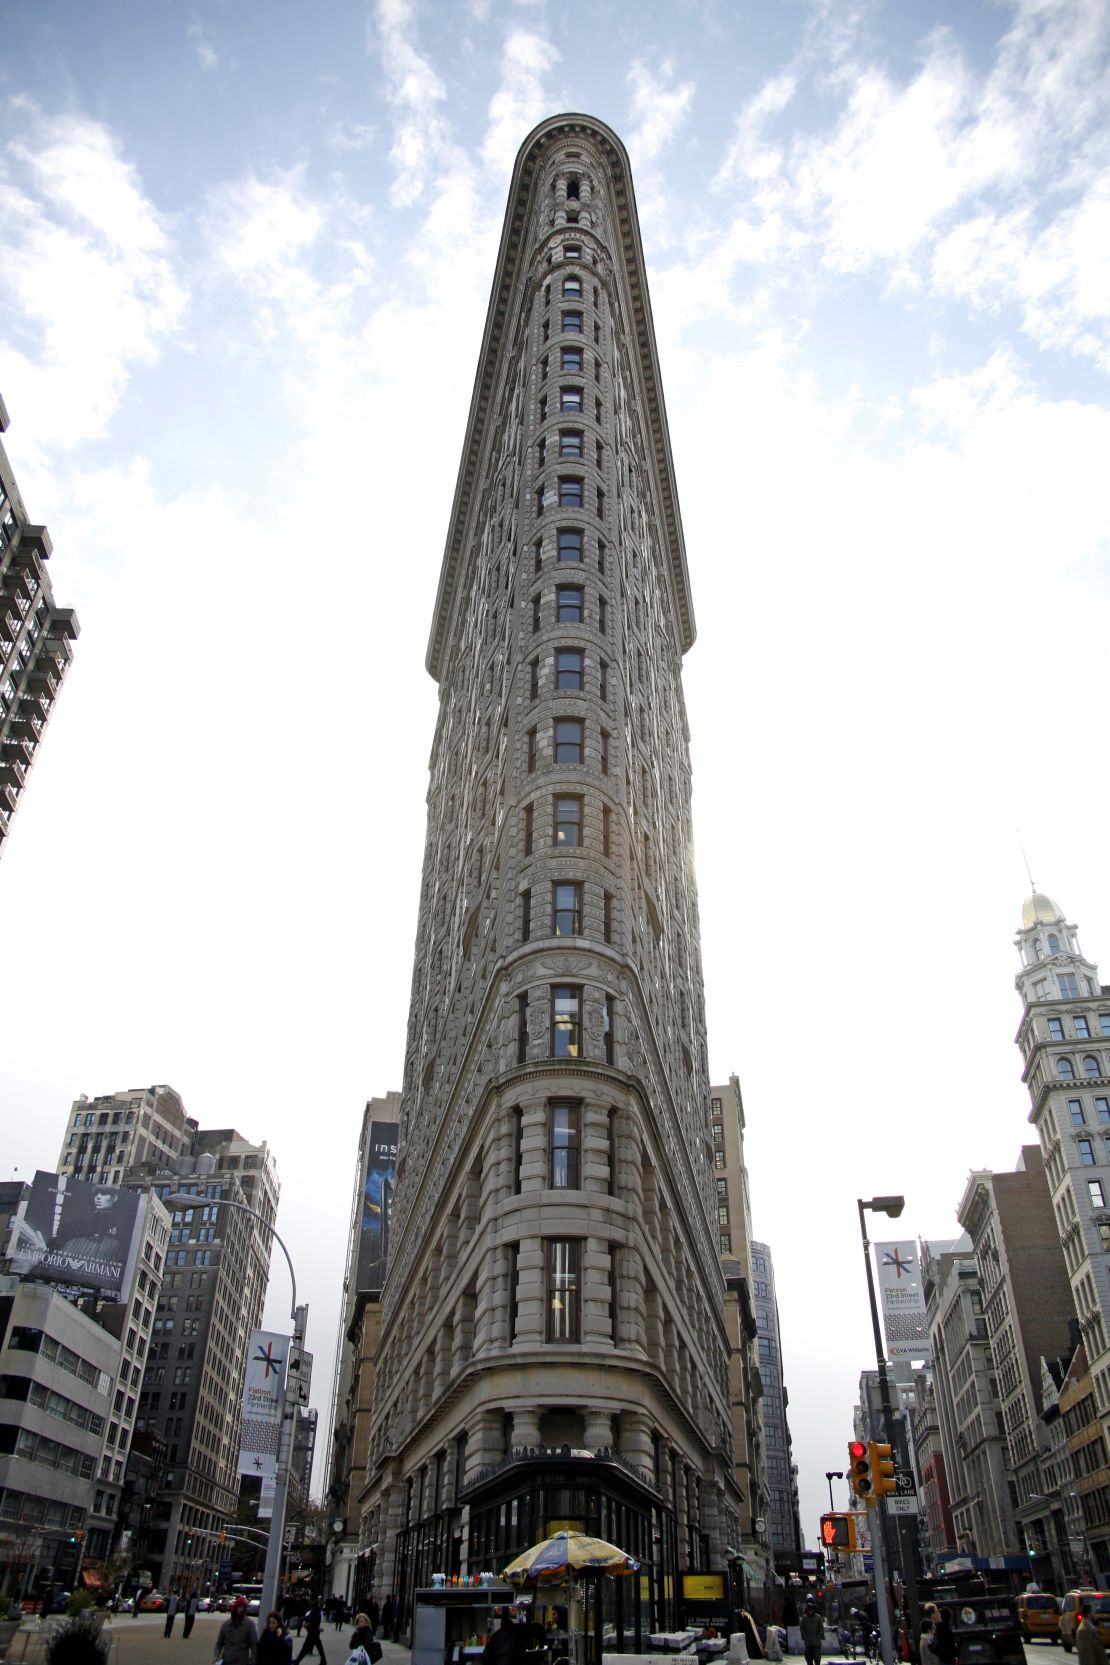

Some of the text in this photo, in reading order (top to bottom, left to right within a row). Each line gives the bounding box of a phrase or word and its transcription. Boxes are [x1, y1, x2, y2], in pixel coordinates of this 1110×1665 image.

[20, 1248, 68, 1267] EMPORIO
[81, 1262, 121, 1279] ARMANI
[248, 1387, 272, 1397] Flatiron
[248, 1394, 262, 1402] 23rd
[900, 1488, 915, 1496] LANE
